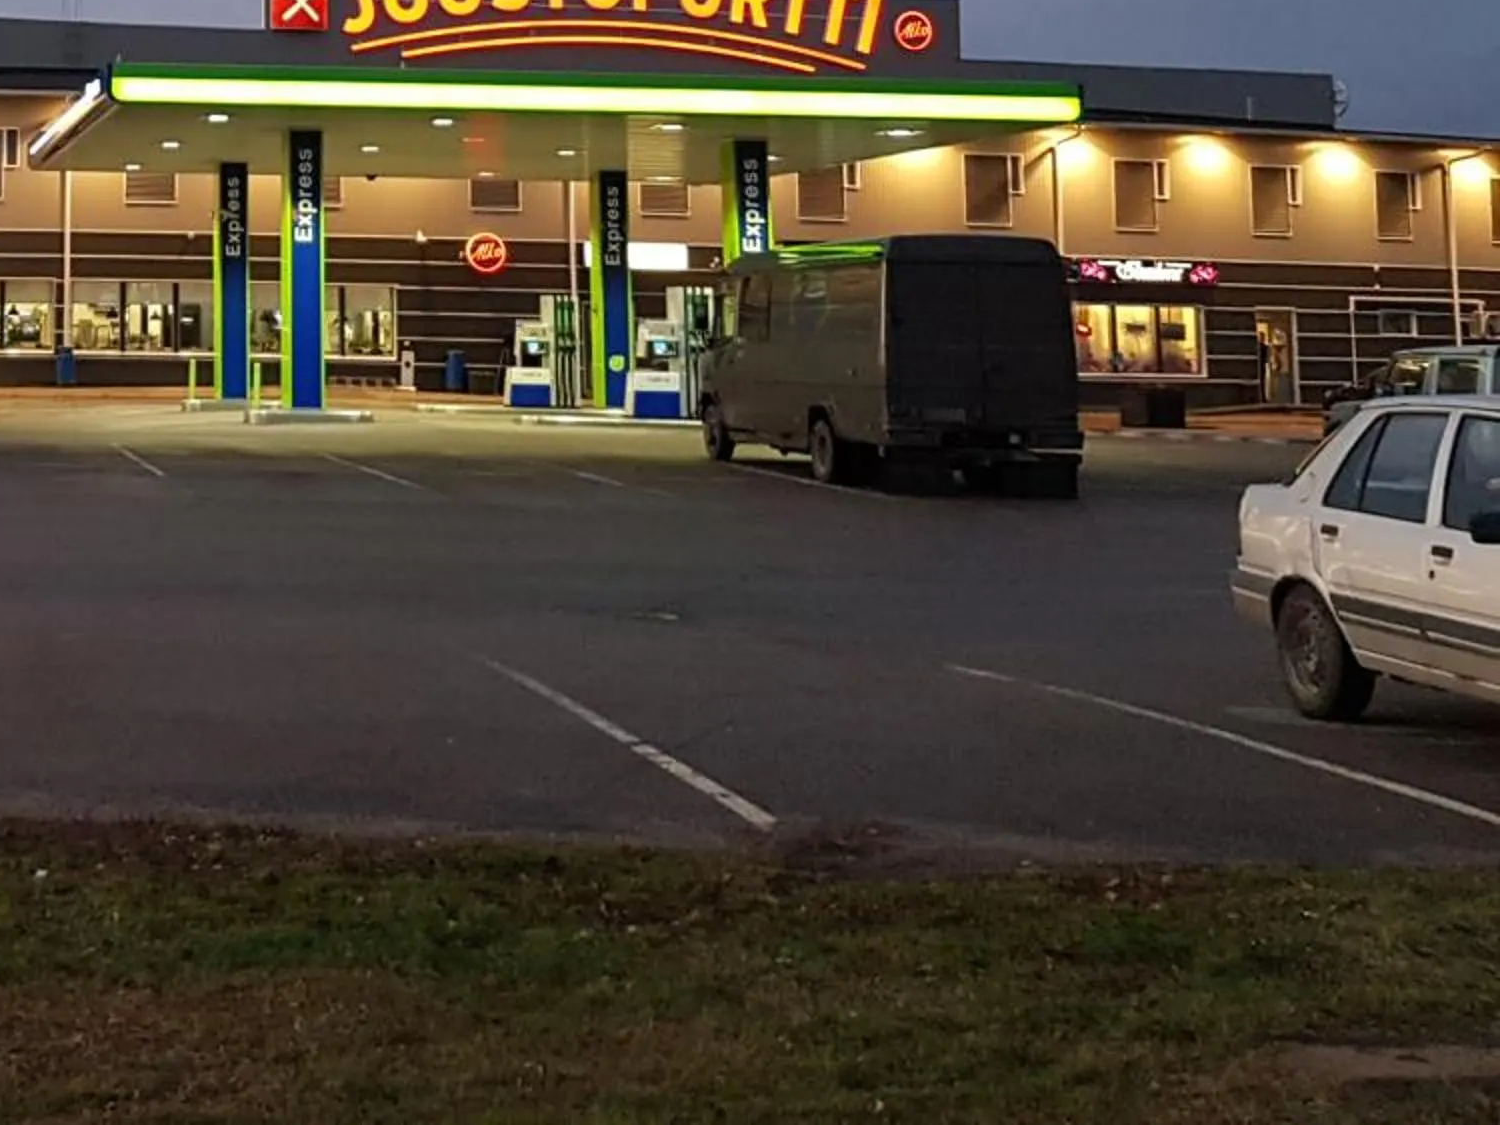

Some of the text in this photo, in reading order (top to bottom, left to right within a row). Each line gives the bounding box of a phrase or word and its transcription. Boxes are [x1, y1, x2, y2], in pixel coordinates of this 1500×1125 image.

[294, 148, 318, 244] Express
[604, 186, 624, 266] Express
[742, 158, 765, 253] Express
